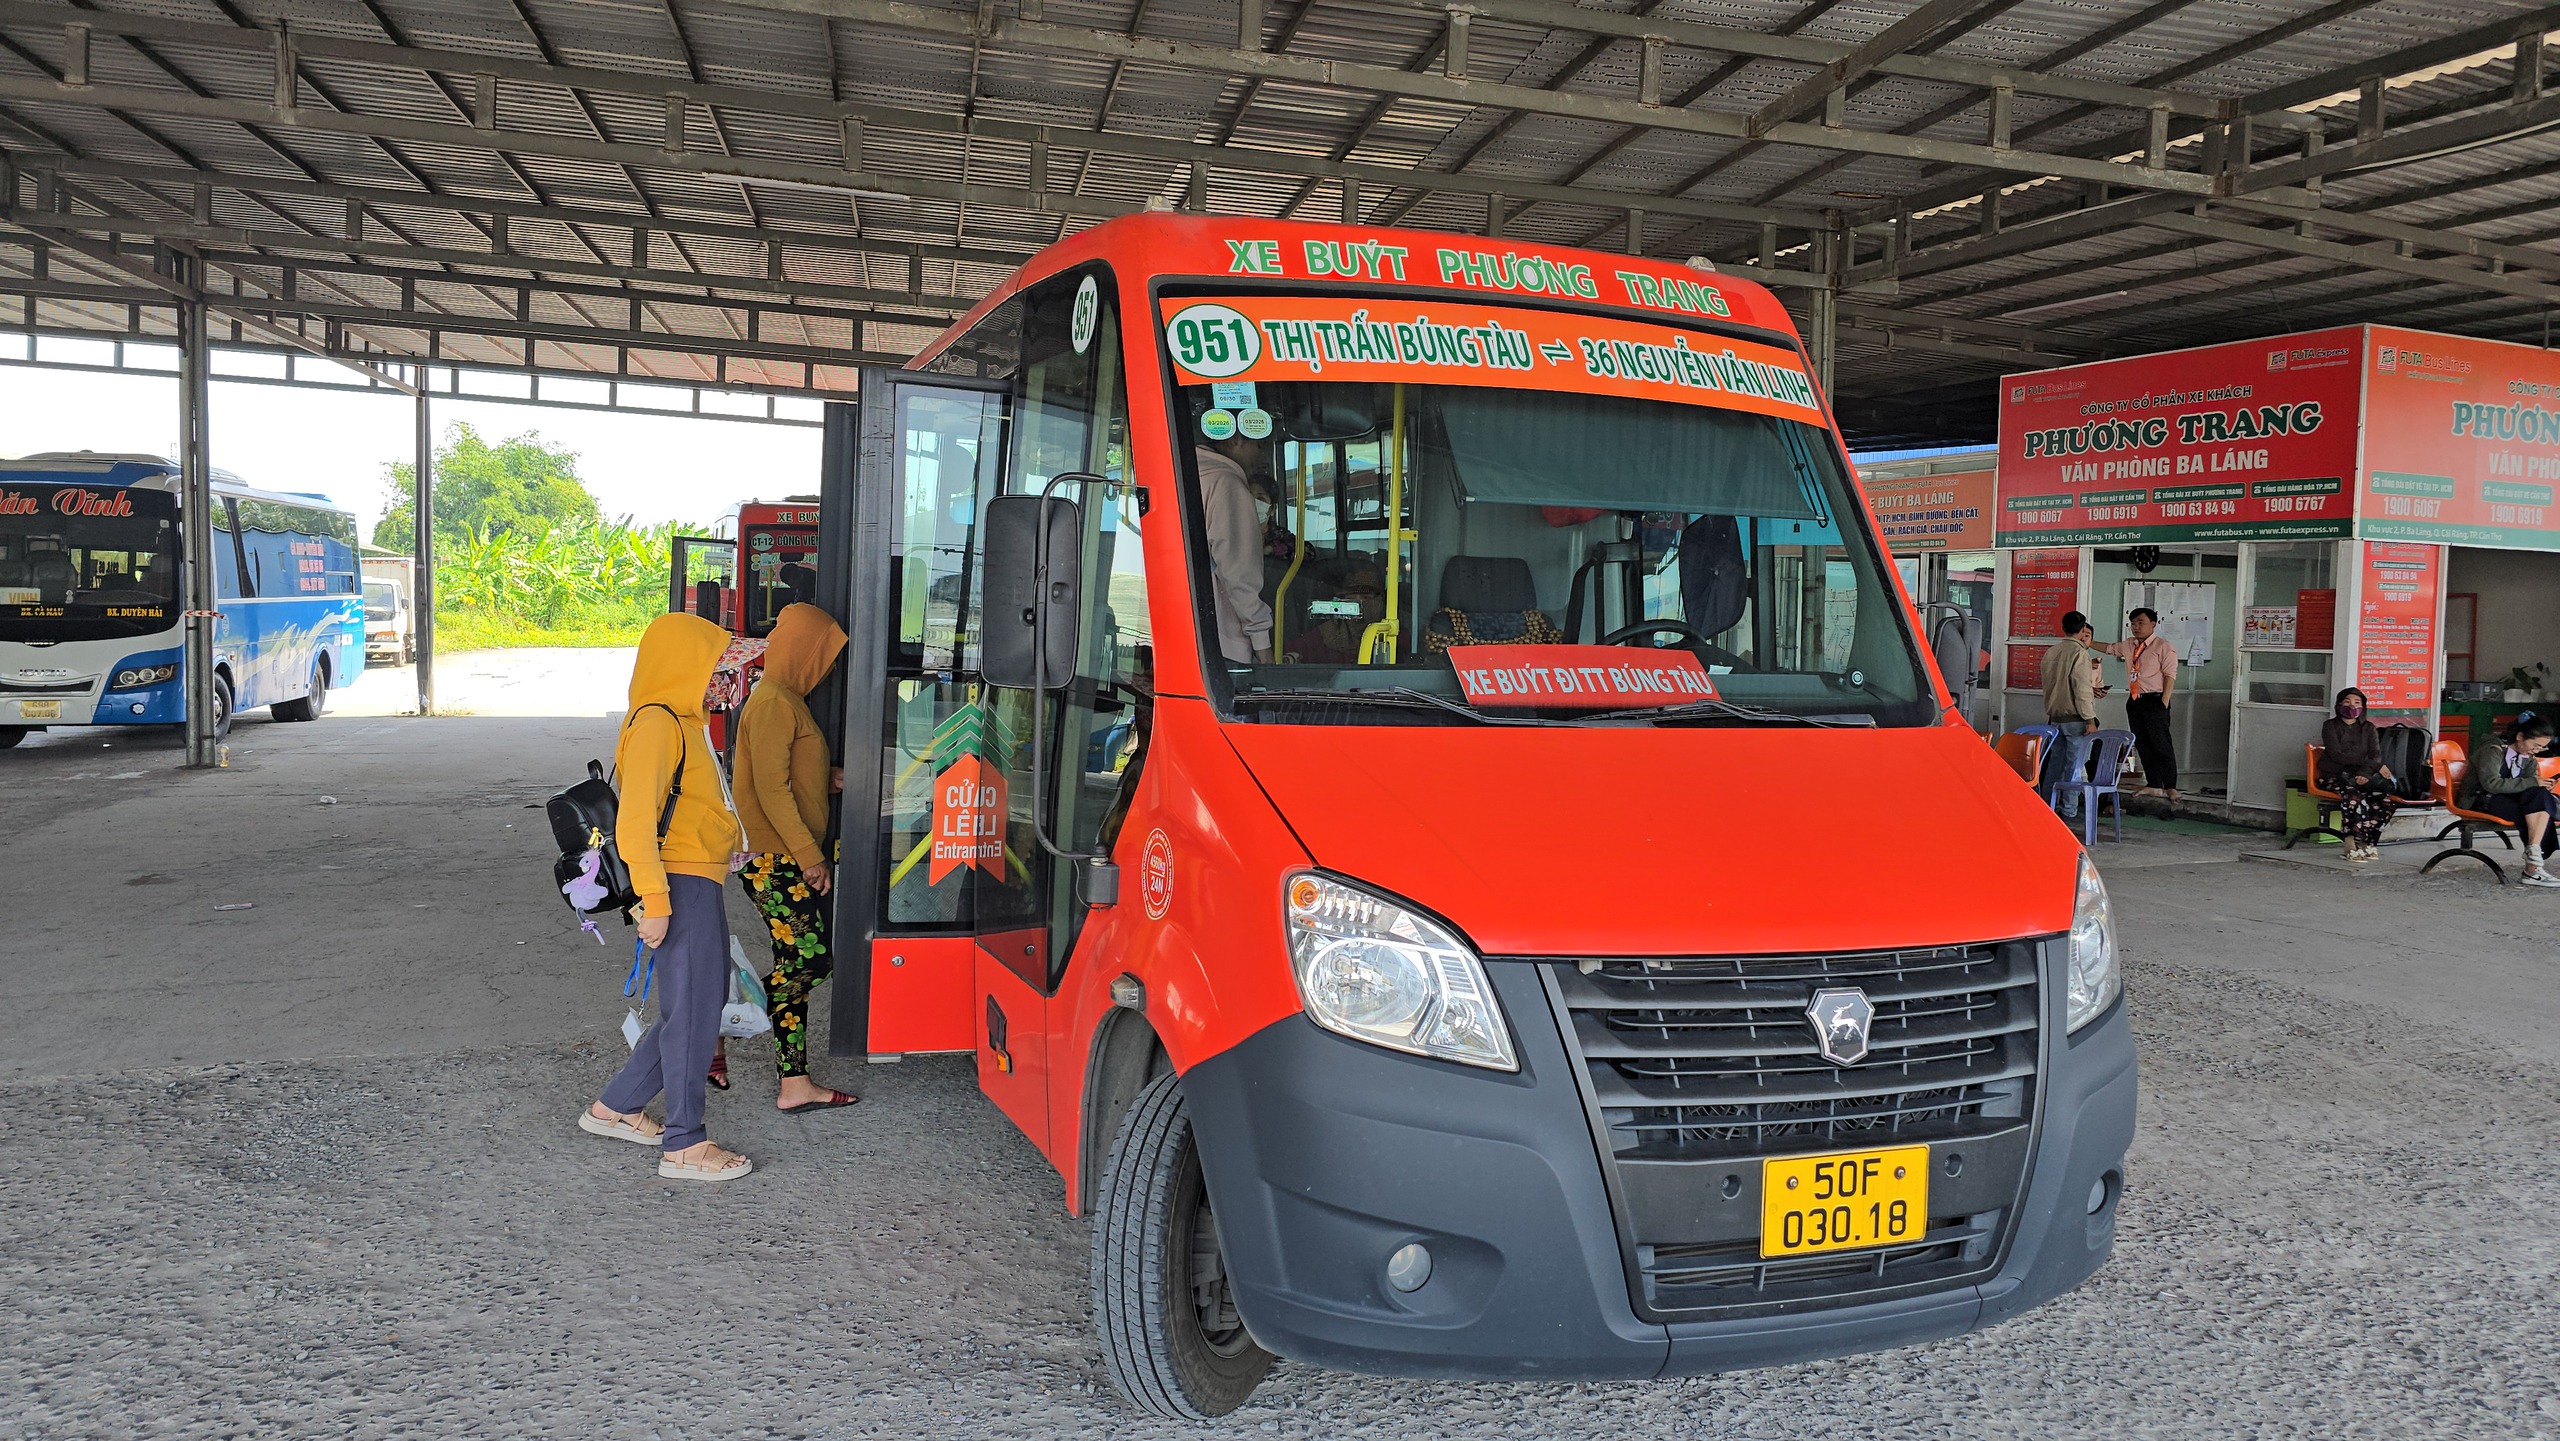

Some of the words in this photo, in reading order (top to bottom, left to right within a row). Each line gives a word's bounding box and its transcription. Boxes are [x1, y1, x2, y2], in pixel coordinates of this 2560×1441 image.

[1225, 239, 1283, 275] XE
[1303, 239, 1408, 281] BUÝT
[1436, 249, 1599, 299] PHƯƠNG
[1615, 270, 1731, 317] TRANG
[1074, 291, 1095, 341] 951
[1176, 318, 1249, 365] 951
[1261, 319, 1323, 373] THỊ
[1316, 309, 1398, 363] TRẤN
[1396, 314, 1478, 368] BÚNG
[1477, 320, 1533, 371] TÀU
[1578, 336, 1619, 379] 36
[1616, 335, 1719, 391] NGUYỄN
[1711, 349, 1768, 400] VĂN
[1760, 364, 1819, 410] LINH
[2291, 350, 2314, 361] FUTA
[2400, 351, 2423, 366] FUTA
[2424, 354, 2443, 370] Bus
[2445, 356, 2471, 373] Lines
[2508, 378, 2539, 396] CÔNG
[2541, 384, 2552, 398] TY
[2080, 400, 2113, 415] CÔNG
[2116, 400, 2129, 411] TY
[2132, 391, 2150, 409] CỔ
[2153, 389, 2185, 407] PHẦN
[2188, 391, 2203, 403] XE
[2207, 384, 2252, 402] KHÁCH
[2023, 417, 2168, 460] PHƯƠNG
[2177, 401, 2324, 445] TRANG
[2451, 401, 2560, 446] PHƯƠN
[2061, 460, 2098, 485] VĂN
[2103, 453, 2170, 481] PHÒNG
[2176, 456, 2205, 475] BA
[2210, 446, 2268, 472] LÁNG
[2489, 449, 2523, 476] VĂN
[2528, 453, 2560, 480] PHÒ
[0, 487, 39, 516] ăn
[52, 488, 134, 517] Vĩnh
[1878, 493, 1905, 509] BUÝT
[1907, 495, 1921, 506] BA
[1925, 490, 1954, 505] LÁNG
[2161, 502, 2186, 517] 1900
[2188, 502, 2202, 516] 63
[2205, 501, 2218, 515] 84
[2221, 501, 2235, 515] 94
[2264, 498, 2292, 513] 1900
[2295, 496, 2326, 511] 6767
[2384, 497, 2410, 516] 1900
[2413, 499, 2441, 518] 6067
[777, 512, 793, 522] XE
[1951, 506, 1963, 518] BẾN
[2017, 511, 2038, 524] 1900
[2040, 510, 2062, 523] 6067
[2088, 508, 2110, 521] 1900
[2113, 506, 2138, 520] 6919
[2491, 505, 2514, 523] 1900
[2518, 507, 2542, 526] 6919
[752, 537, 773, 546] CT-12
[777, 534, 801, 546] CÔNG
[803, 533, 817, 546] VIÊ
[2018, 536, 2028, 545] vực
[2041, 535, 2049, 543] Ba
[2075, 533, 2084, 541] Cái
[2104, 532, 2114, 541] TP.
[2115, 531, 2127, 540] Cần
[2128, 531, 2141, 540] Thơ
[2194, 528, 2253, 538] www.futabus.vn
[2259, 525, 2339, 537] www.futaexpress.vn
[2368, 524, 2380, 533] Khu
[2381, 526, 2393, 536] vực
[2407, 527, 2415, 535] Ba
[2470, 530, 2478, 539] TP.
[8, 592, 38, 604] VINH
[107, 609, 120, 617] BX.
[121, 607, 147, 617] DUYÊN
[148, 605, 163, 617] HẢI
[1461, 668, 1496, 695] XE
[1498, 663, 1555, 694] BUÝT
[1556, 667, 1580, 693] ĐI
[1579, 667, 1608, 693] TT
[1612, 662, 1672, 694] BÚNG
[1667, 664, 1713, 694] TÀU
[1814, 1158, 1881, 1199] 50F
[1784, 1200, 1907, 1248] 030.18
